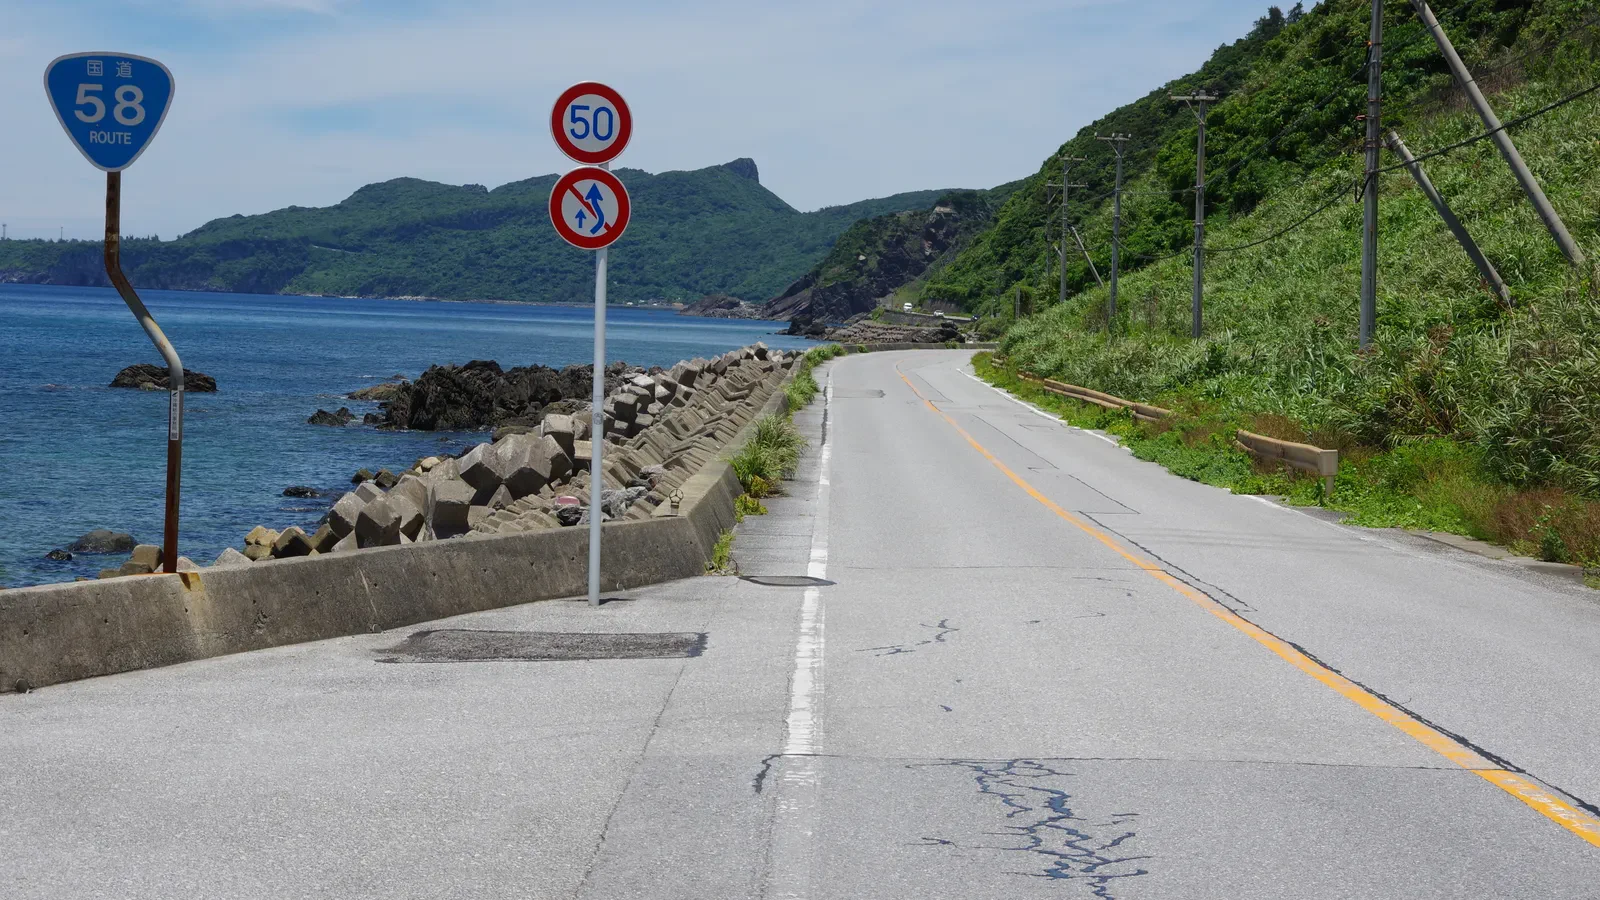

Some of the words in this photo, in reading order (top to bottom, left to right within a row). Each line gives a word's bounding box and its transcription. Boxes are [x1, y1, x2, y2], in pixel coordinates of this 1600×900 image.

[87, 60, 133, 78] 国道
[74, 83, 146, 126] 58
[571, 105, 613, 141] 50
[90, 131, 132, 144] ROUTE
